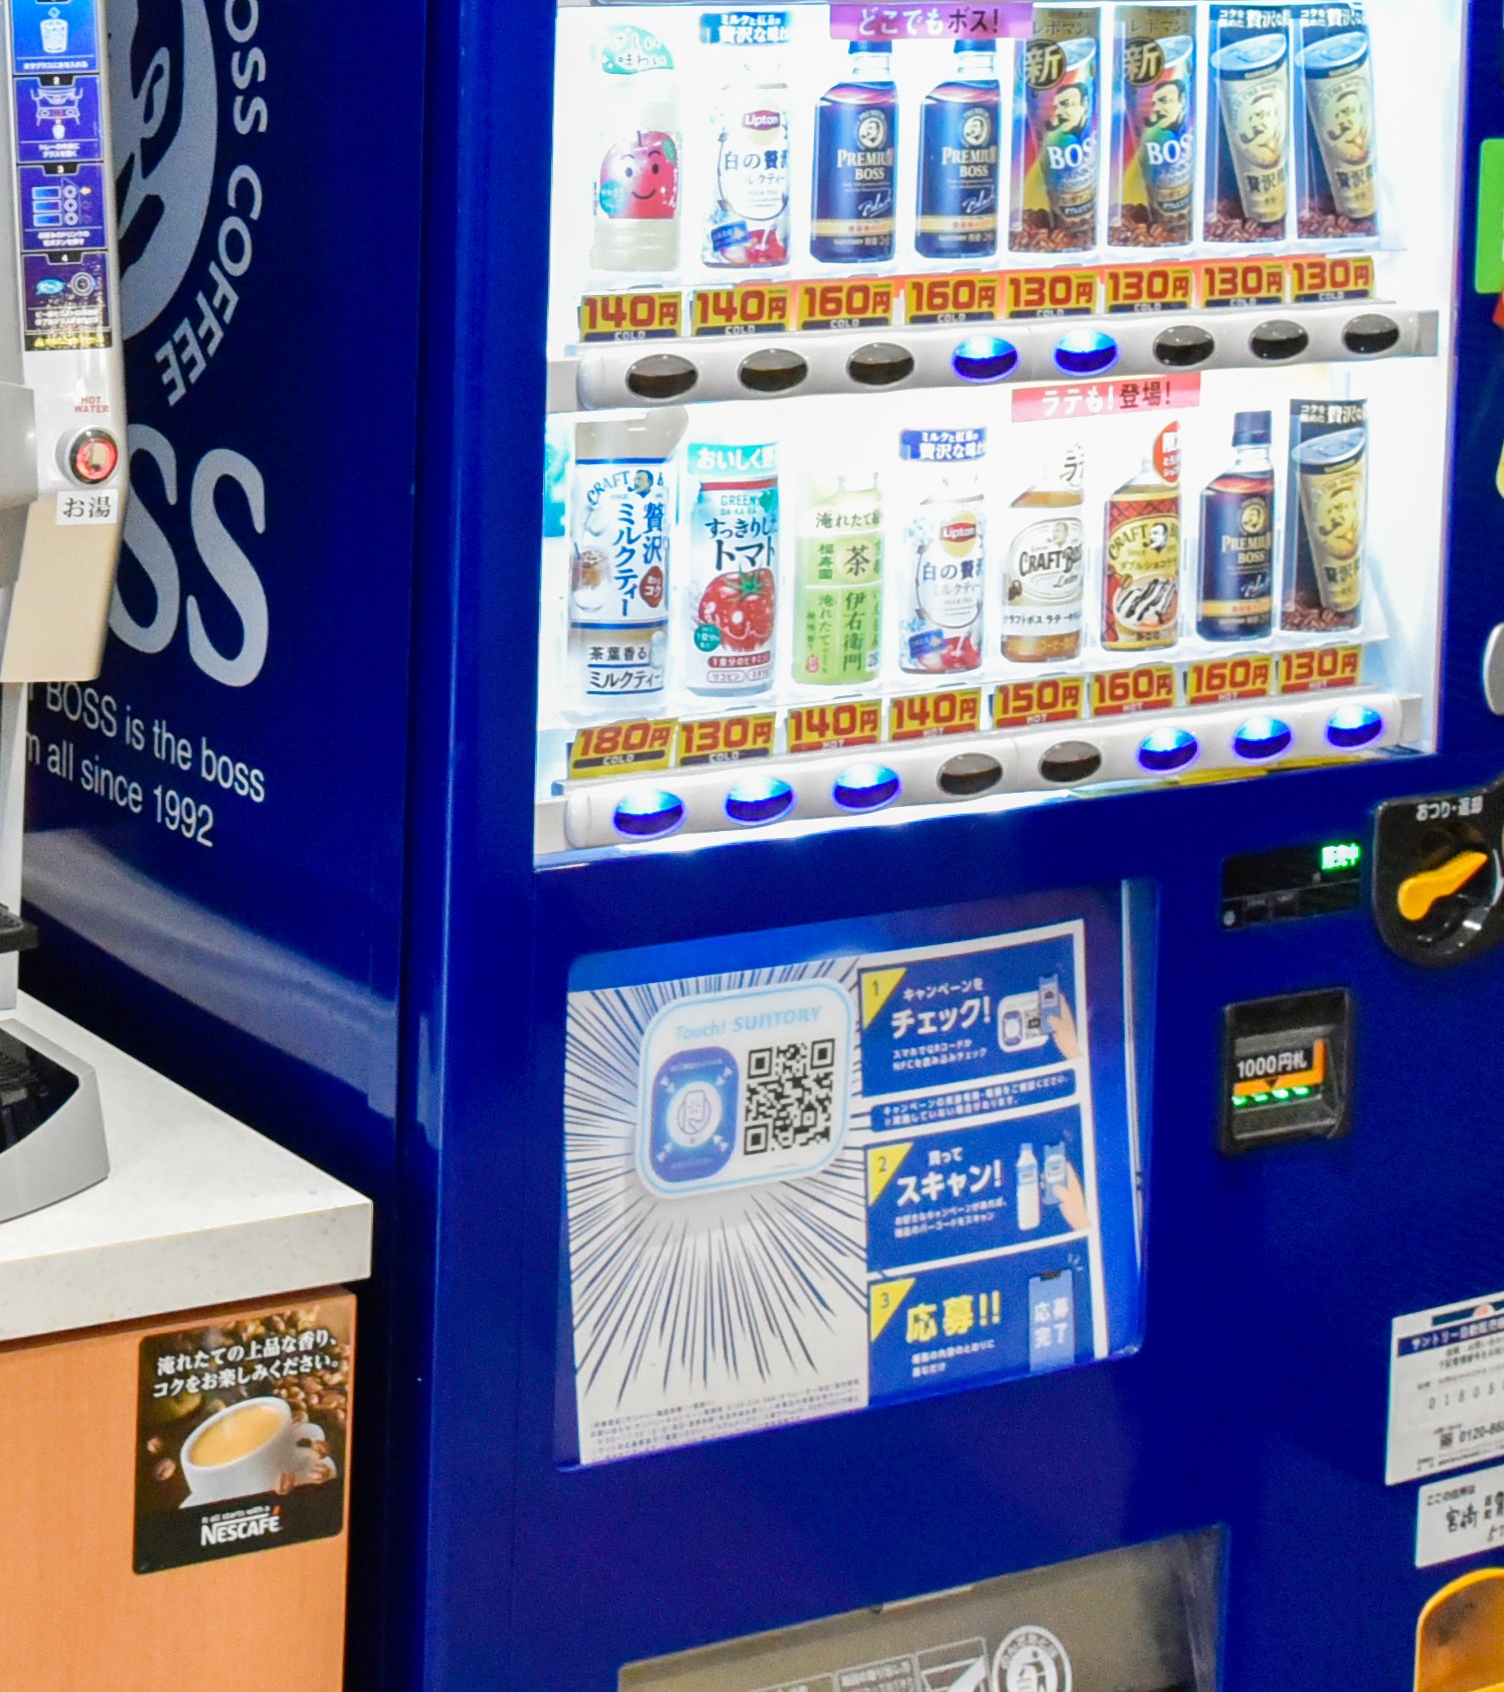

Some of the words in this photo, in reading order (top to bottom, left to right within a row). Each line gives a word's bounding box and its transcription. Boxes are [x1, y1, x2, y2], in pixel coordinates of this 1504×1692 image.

[858, 8, 1000, 35] どこでもボス!
[1026, 46, 1062, 84] 新
[1125, 43, 1163, 80] 新
[744, 113, 780, 127] Lipton
[855, 168, 885, 180] BOSS
[959, 166, 989, 178] BOSS
[154, 164, 263, 407] COFFEE
[1009, 276, 1093, 307] 130円
[1108, 270, 1189, 301] 130円
[1205, 266, 1283, 297] 130円
[1294, 260, 1369, 291] 130円
[584, 294, 679, 329] 140円
[696, 288, 788, 323] 140円
[804, 283, 892, 318] 160円
[912, 278, 996, 311] 160円
[73, 403, 109, 413] WATER
[81, 396, 101, 404] HOT
[1042, 381, 1171, 416] ラテも!登場!
[586, 470, 631, 505] CRAFT
[63, 492, 113, 522] お湯
[642, 502, 665, 564] 贅沢
[942, 525, 976, 539] Lipton
[1108, 522, 1147, 562] CRAFT
[613, 503, 640, 617] ミルクティー
[716, 540, 775, 571] トマト
[843, 543, 870, 579] 茶
[1019, 549, 1063, 578] CRAFT
[1238, 552, 1265, 564] BOSS
[843, 591, 867, 672] 伊右衛門
[589, 647, 647, 660] 茶葉香る
[1282, 648, 1358, 682] 130円
[588, 670, 663, 690] ミルクティー
[1094, 669, 1173, 704] 160円
[1195, 656, 1268, 692] 160円
[893, 693, 977, 730] 140円
[998, 680, 1080, 715] 150円
[681, 717, 772, 754] 130円
[791, 704, 878, 741] 140円
[46, 680, 118, 739] BOSS
[124, 704, 146, 752] is
[152, 718, 193, 775] the
[199, 737, 266, 804] boss
[580, 723, 669, 758] 180円
[47, 739, 76, 783] all
[80, 758, 144, 814] since
[151, 785, 215, 848] 1992
[873, 980, 880, 996] 1
[903, 978, 984, 1002] キャンペーンを
[674, 1016, 727, 1043] Touch!
[732, 1004, 822, 1034] SUNTORY
[891, 996, 991, 1039] チェック!
[1237, 1049, 1308, 1079] 1000円札
[877, 1156, 887, 1172] 2
[896, 1159, 1002, 1206] スキャン!
[880, 1293, 890, 1309] 3
[905, 1290, 1001, 1344] 応募!!
[157, 1329, 336, 1376] 淹れたての上品な香り、
[1034, 1323, 1068, 1349] 完了
[153, 1355, 339, 1399] コクをお楽しみください。
[201, 1506, 281, 1546] NESCAFÉ
